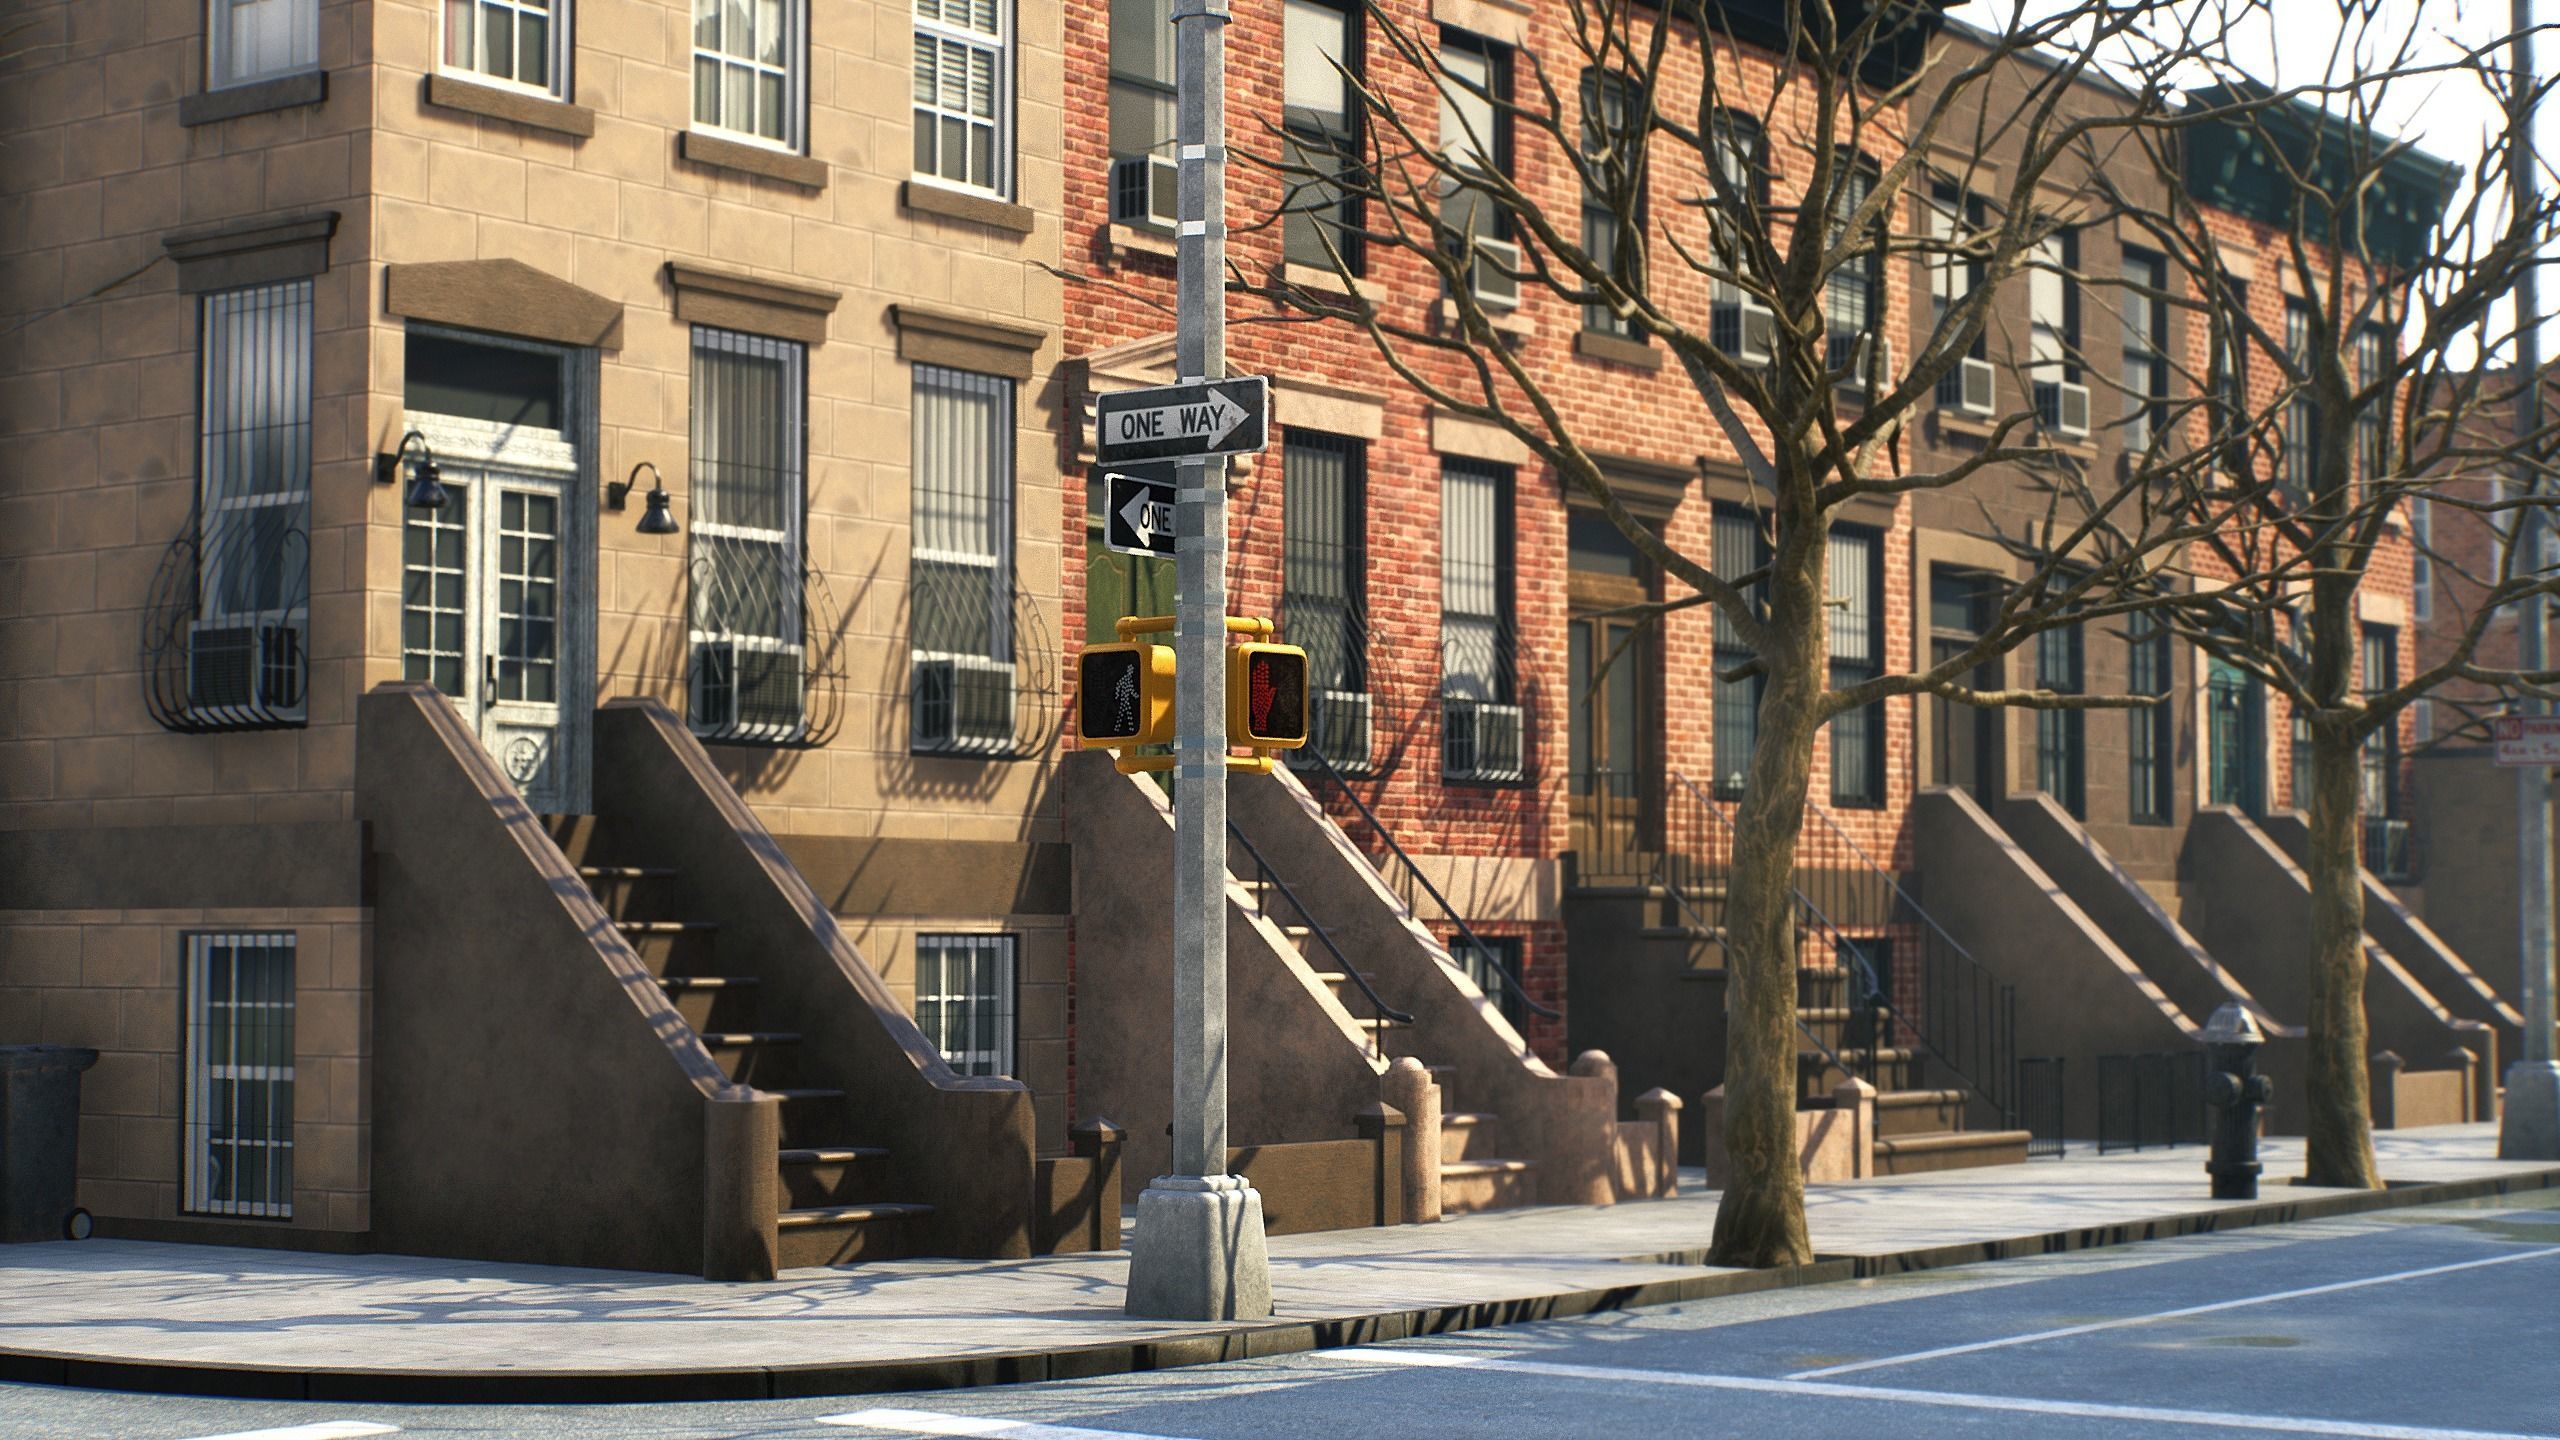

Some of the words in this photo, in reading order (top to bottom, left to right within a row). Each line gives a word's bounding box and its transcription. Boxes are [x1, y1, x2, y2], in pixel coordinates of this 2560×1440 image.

[1121, 410, 1164, 440] ONE
[1180, 404, 1226, 435] WAY
[1140, 503, 1171, 532] ONE
[2498, 720, 2521, 738] NO
